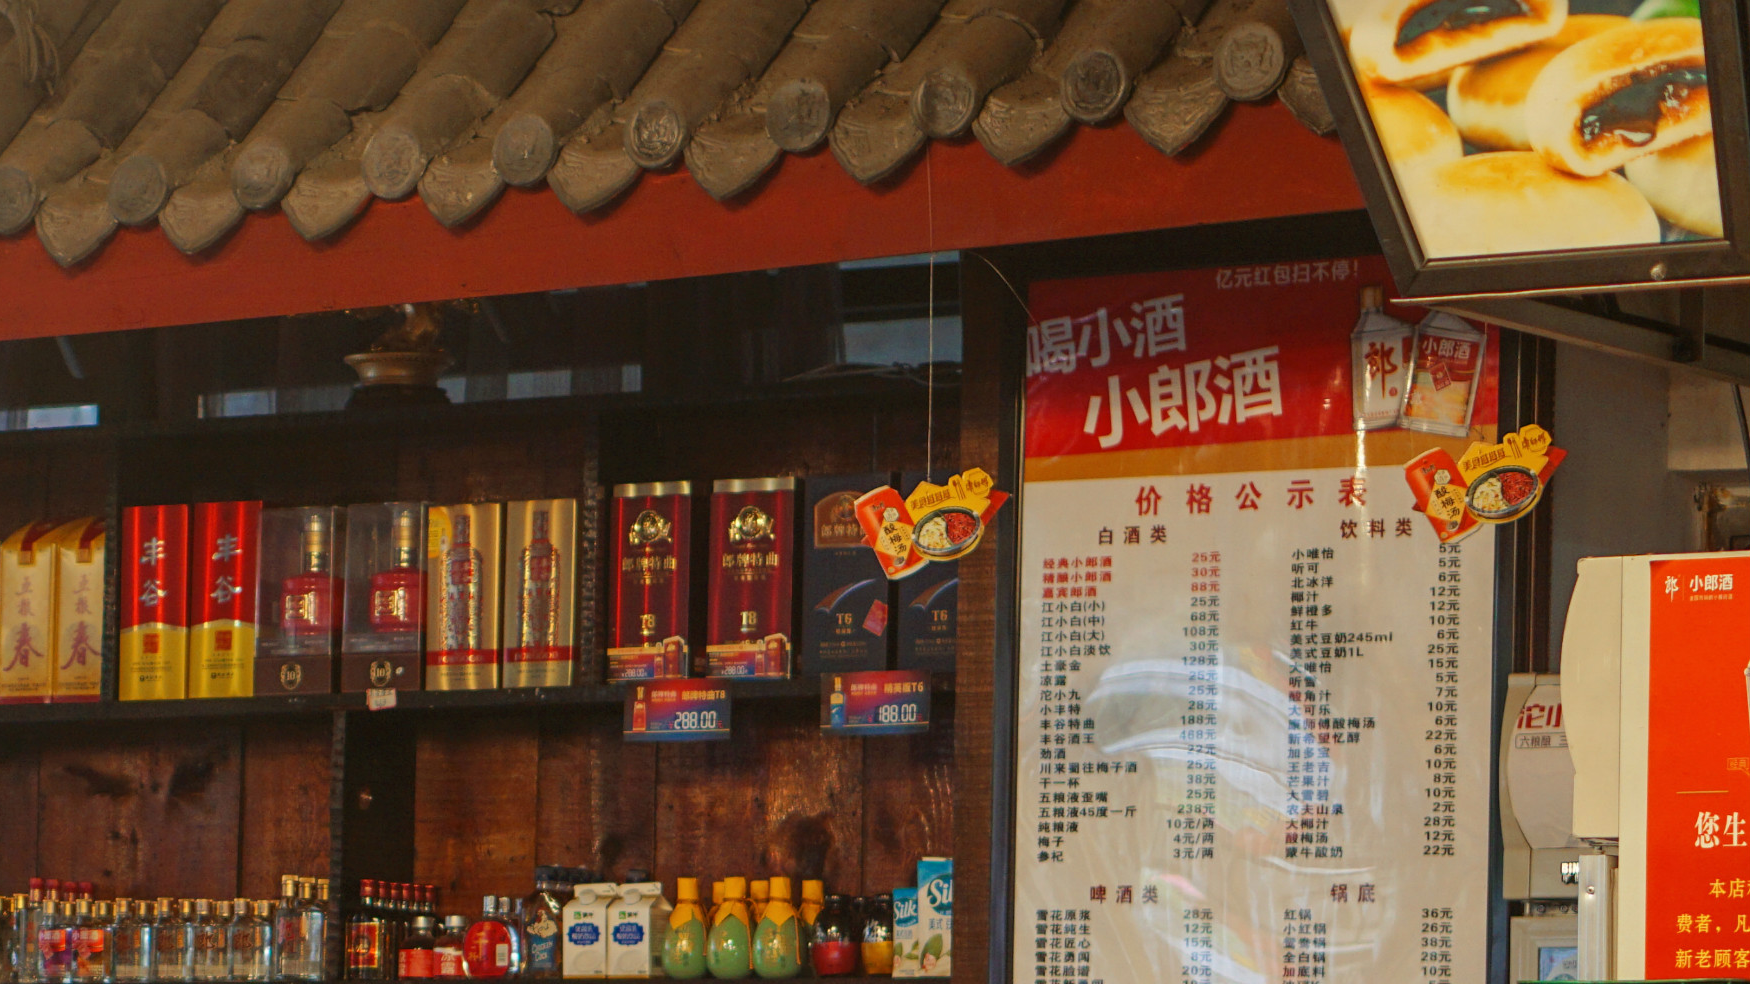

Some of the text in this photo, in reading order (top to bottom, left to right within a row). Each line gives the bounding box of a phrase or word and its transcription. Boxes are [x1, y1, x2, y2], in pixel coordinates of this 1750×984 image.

[1027, 293, 1187, 377] 喝小酒
[1421, 337, 1472, 359] 小郎酒
[1084, 346, 1282, 448] 小郎酒
[1135, 477, 1367, 516] 价格公示表
[1433, 487, 1462, 519] 酸梅汤
[1099, 524, 1167, 545] 白酒类
[1340, 517, 1413, 539] 饮料类
[884, 523, 907, 554] 酸梅汤
[1042, 551, 1221, 570] 经典小郎酒 25元
[1291, 543, 1461, 561] 小唯怡 5元
[140, 537, 168, 607] 丰谷
[210, 534, 243, 604] 丰谷
[1291, 571, 1461, 589] 北冰洋 6元
[1689, 573, 1734, 592] 小郎酒
[931, 609, 948, 622] T6
[1290, 600, 1460, 617] 鲜橙多 12元
[836, 612, 853, 625] T6
[1290, 614, 1460, 631] 红牛 10元
[1290, 629, 1460, 646] 美式豆奶245ml 6元
[1040, 641, 1219, 657] 江小白淡饮 30元
[1290, 643, 1459, 659] 美式豆奶1L 25元
[1040, 655, 1219, 672] 土豪金 128元
[1040, 685, 1218, 701] 沱小九 25元
[1039, 699, 1218, 716] 小丰特 28元
[1288, 701, 1458, 717] 大可乐 10元
[1039, 714, 1218, 730] 丰谷特曲 188元
[1288, 715, 1458, 731] 康师傅酸梅汤 6元
[1287, 744, 1457, 759] 加多宝 6元
[1287, 759, 1457, 773] 王老吉 10元
[1038, 803, 1216, 819] 五粮液45度一斤 238元
[1286, 802, 1456, 816] 农夫山泉 2元
[1037, 817, 1215, 833] 纯粮液 10元/两
[1286, 816, 1455, 830] 大椰汁 28元
[1037, 832, 1215, 848] 梅子 4元/两
[1089, 884, 1159, 905] 啤酒类
[1330, 883, 1376, 904] 锅底
[893, 900, 918, 920] Silk
[1036, 908, 1213, 921] 雪花原浆 28元
[1283, 907, 1453, 921] 红锅 36元
[1035, 922, 1213, 935] 雪花纯生 12元
[1283, 922, 1453, 935] 小红锅 26元
[1283, 951, 1452, 964] 全白锅 28元
[1282, 965, 1452, 978] 加底料 10元
